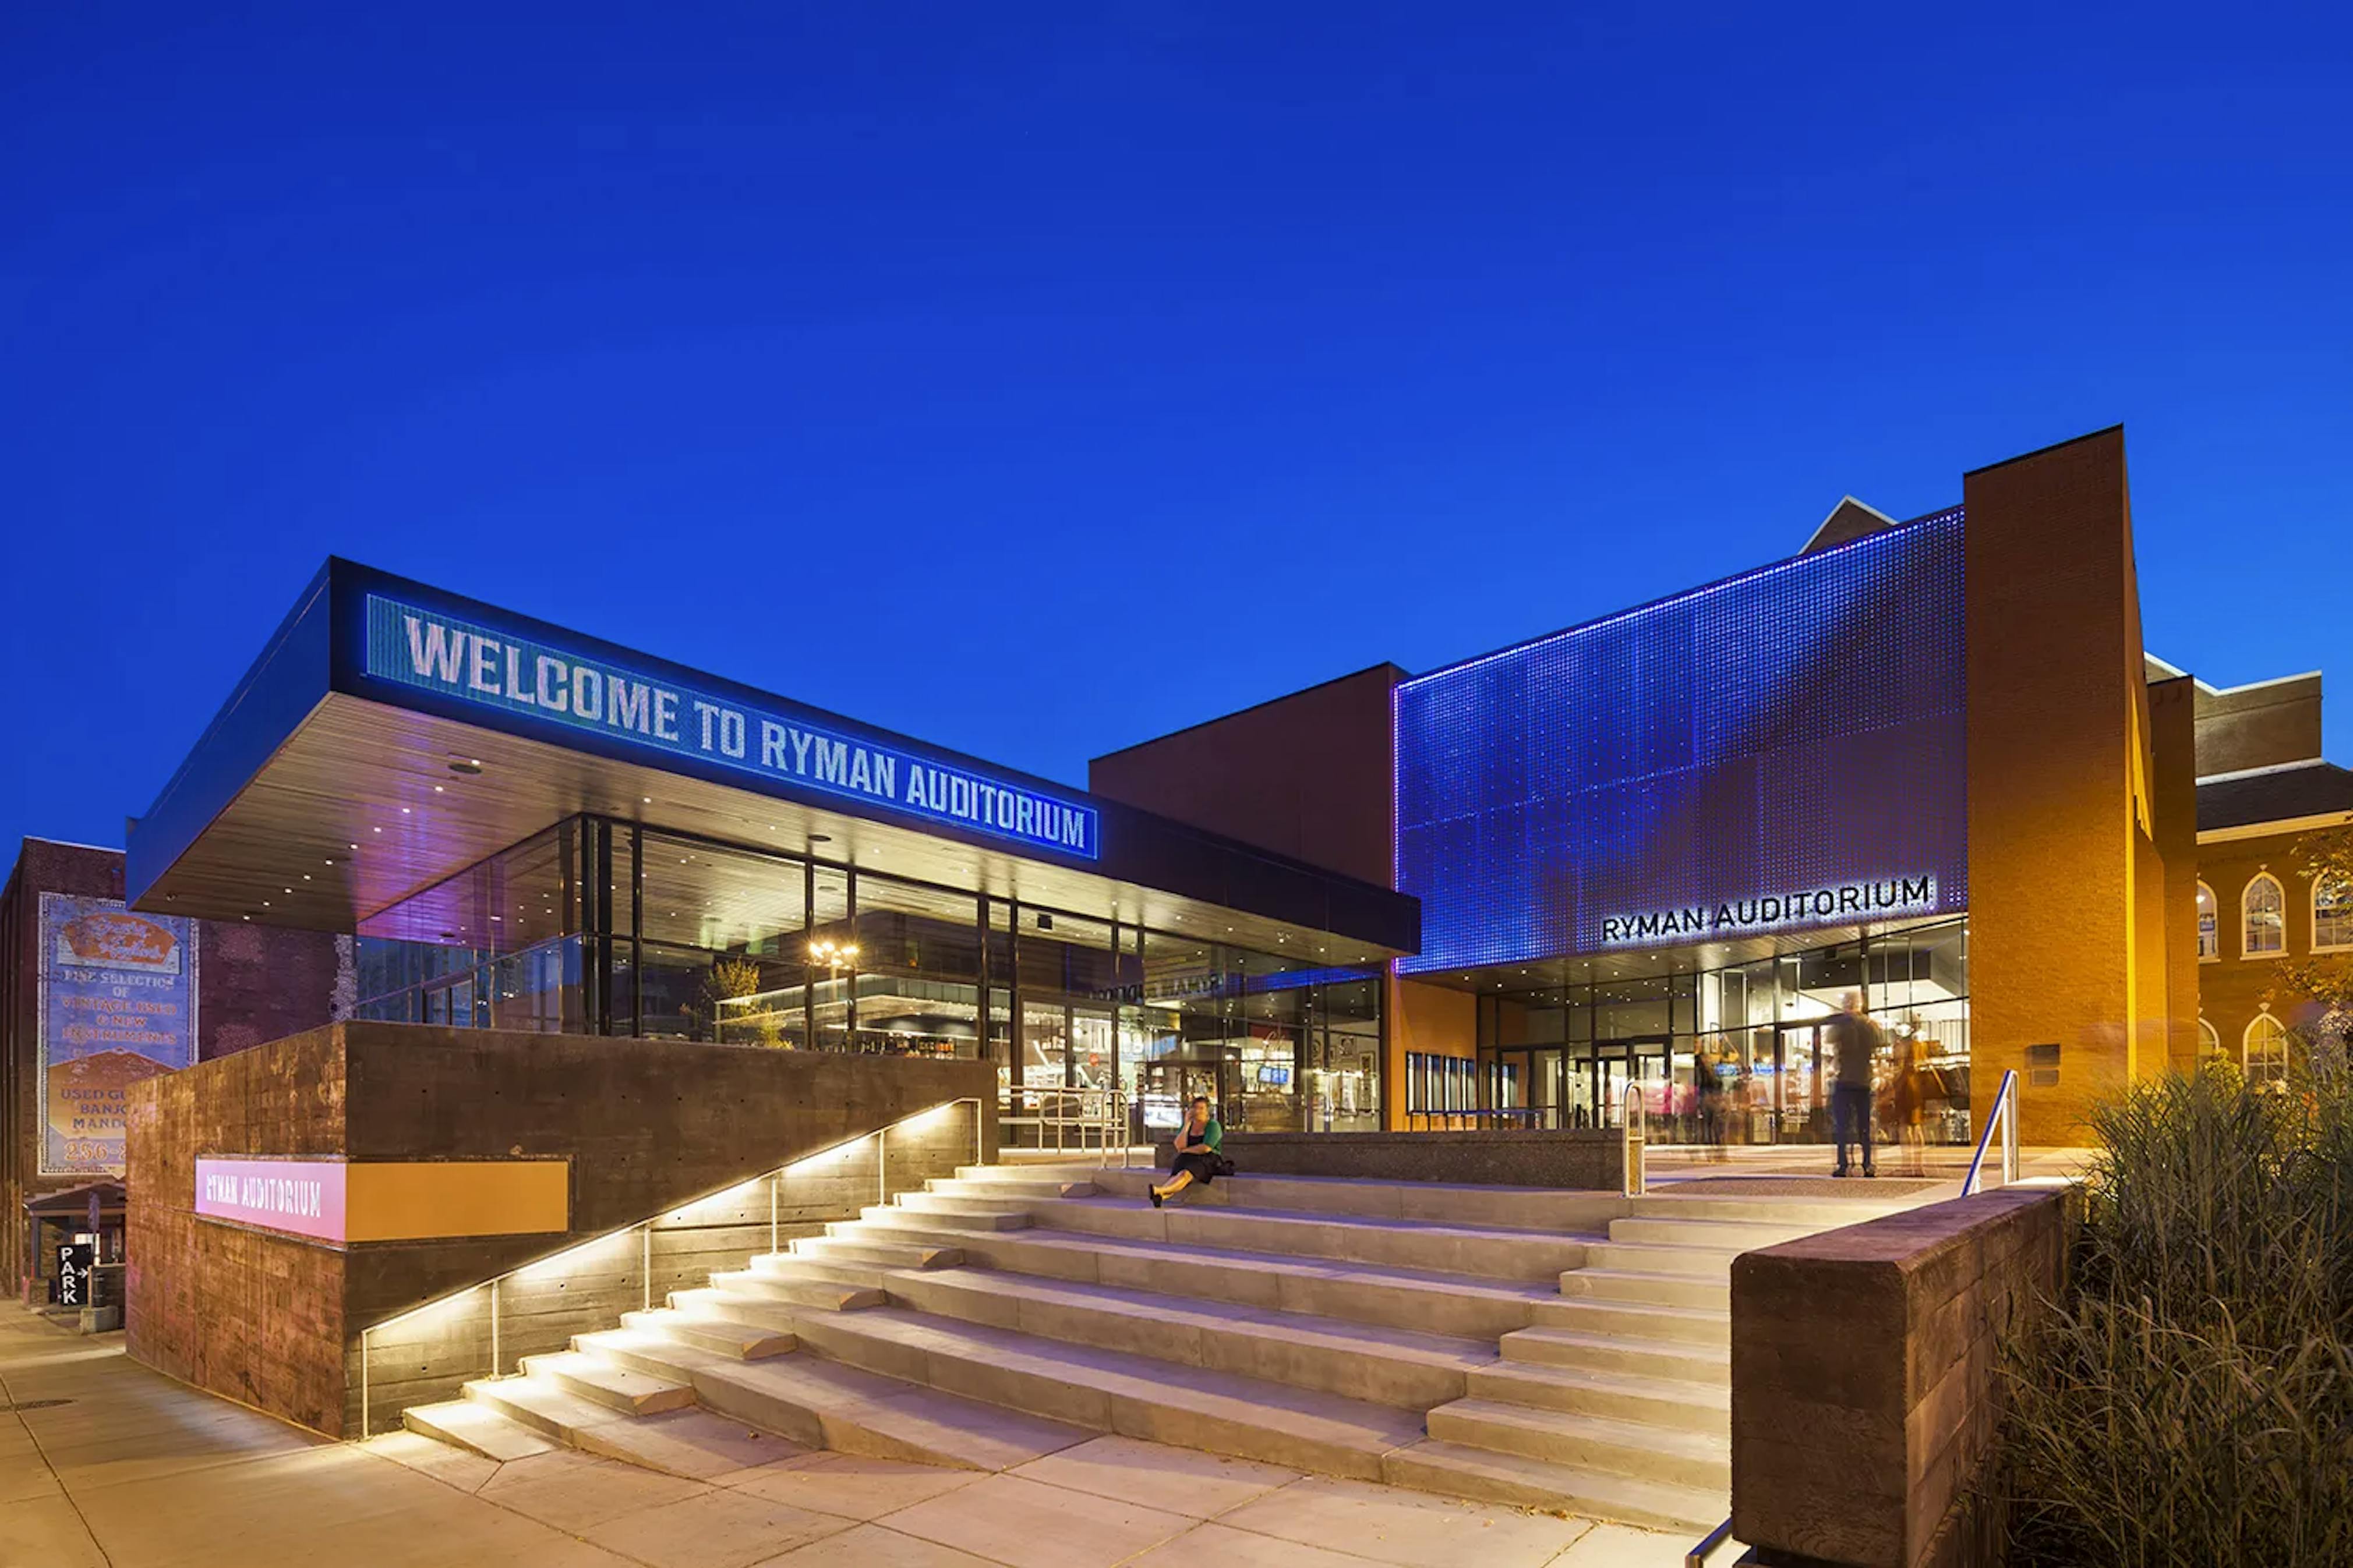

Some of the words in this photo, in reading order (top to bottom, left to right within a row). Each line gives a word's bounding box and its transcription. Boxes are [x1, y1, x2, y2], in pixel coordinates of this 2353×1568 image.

[404, 615, 679, 741] WELCOME
[694, 700, 745, 759] TO
[762, 718, 896, 799] RYMAN
[906, 763, 1085, 849] AUDITORIUM
[1602, 907, 1702, 941] RYMAN
[1713, 876, 1929, 929] AUDITORIUM
[100, 973, 174, 988] SELECTION
[112, 986, 130, 998] OF
[137, 1001, 177, 1015] USED
[112, 1015, 148, 1028] NEW
[62, 1027, 177, 1045] INSTRUMENTS
[61, 1089, 104, 1100] USED
[206, 1173, 238, 1205] RYMAN
[241, 1177, 321, 1217] AUDITORIUM
[60, 1247, 77, 1304] PARK
